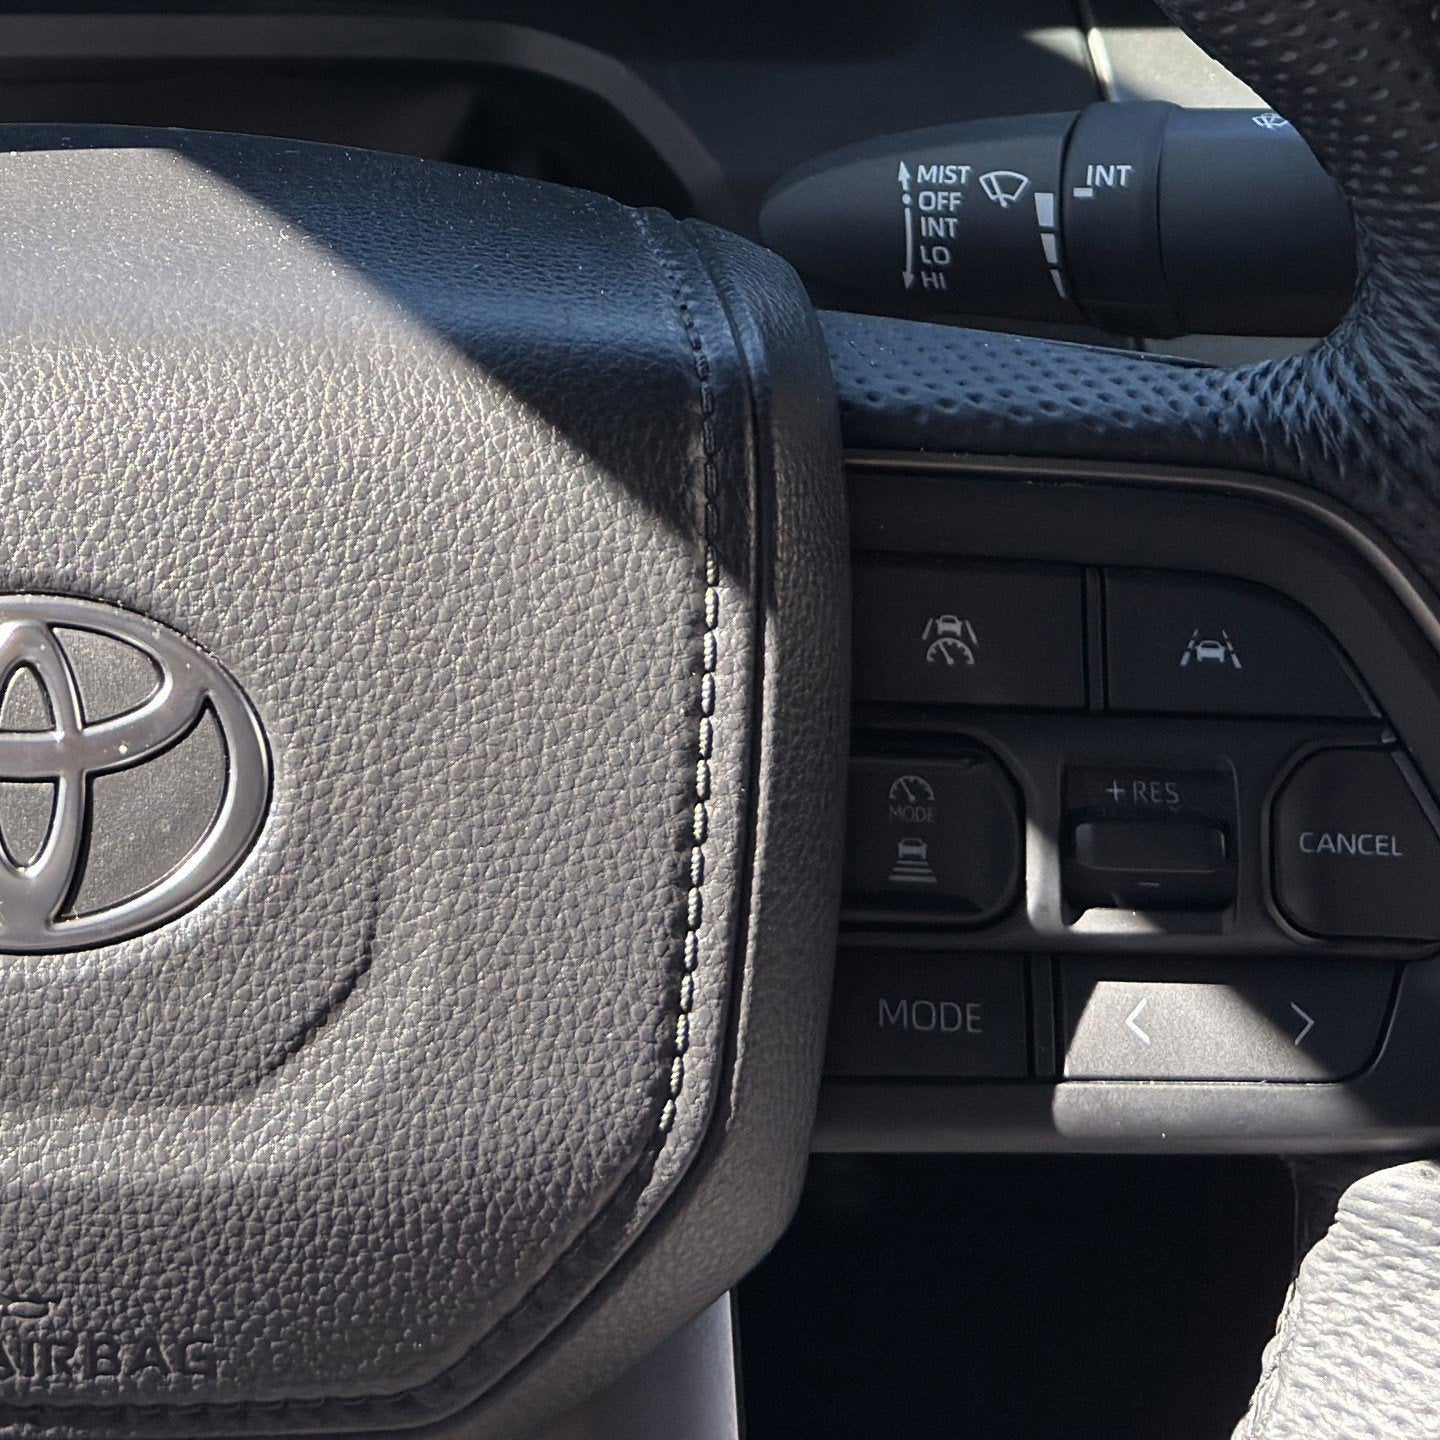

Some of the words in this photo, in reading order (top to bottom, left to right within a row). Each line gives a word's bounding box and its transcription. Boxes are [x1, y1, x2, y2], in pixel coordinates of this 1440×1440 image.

[917, 164, 971, 185] MIST
[1086, 164, 1132, 187] INT
[918, 191, 963, 212] OFF
[920, 217, 958, 238] INT
[920, 245, 951, 266] LO
[921, 271, 946, 290] HI
[888, 805, 934, 823] MODE
[1299, 830, 1402, 858] CANCEL
[877, 997, 982, 1034] MODE
